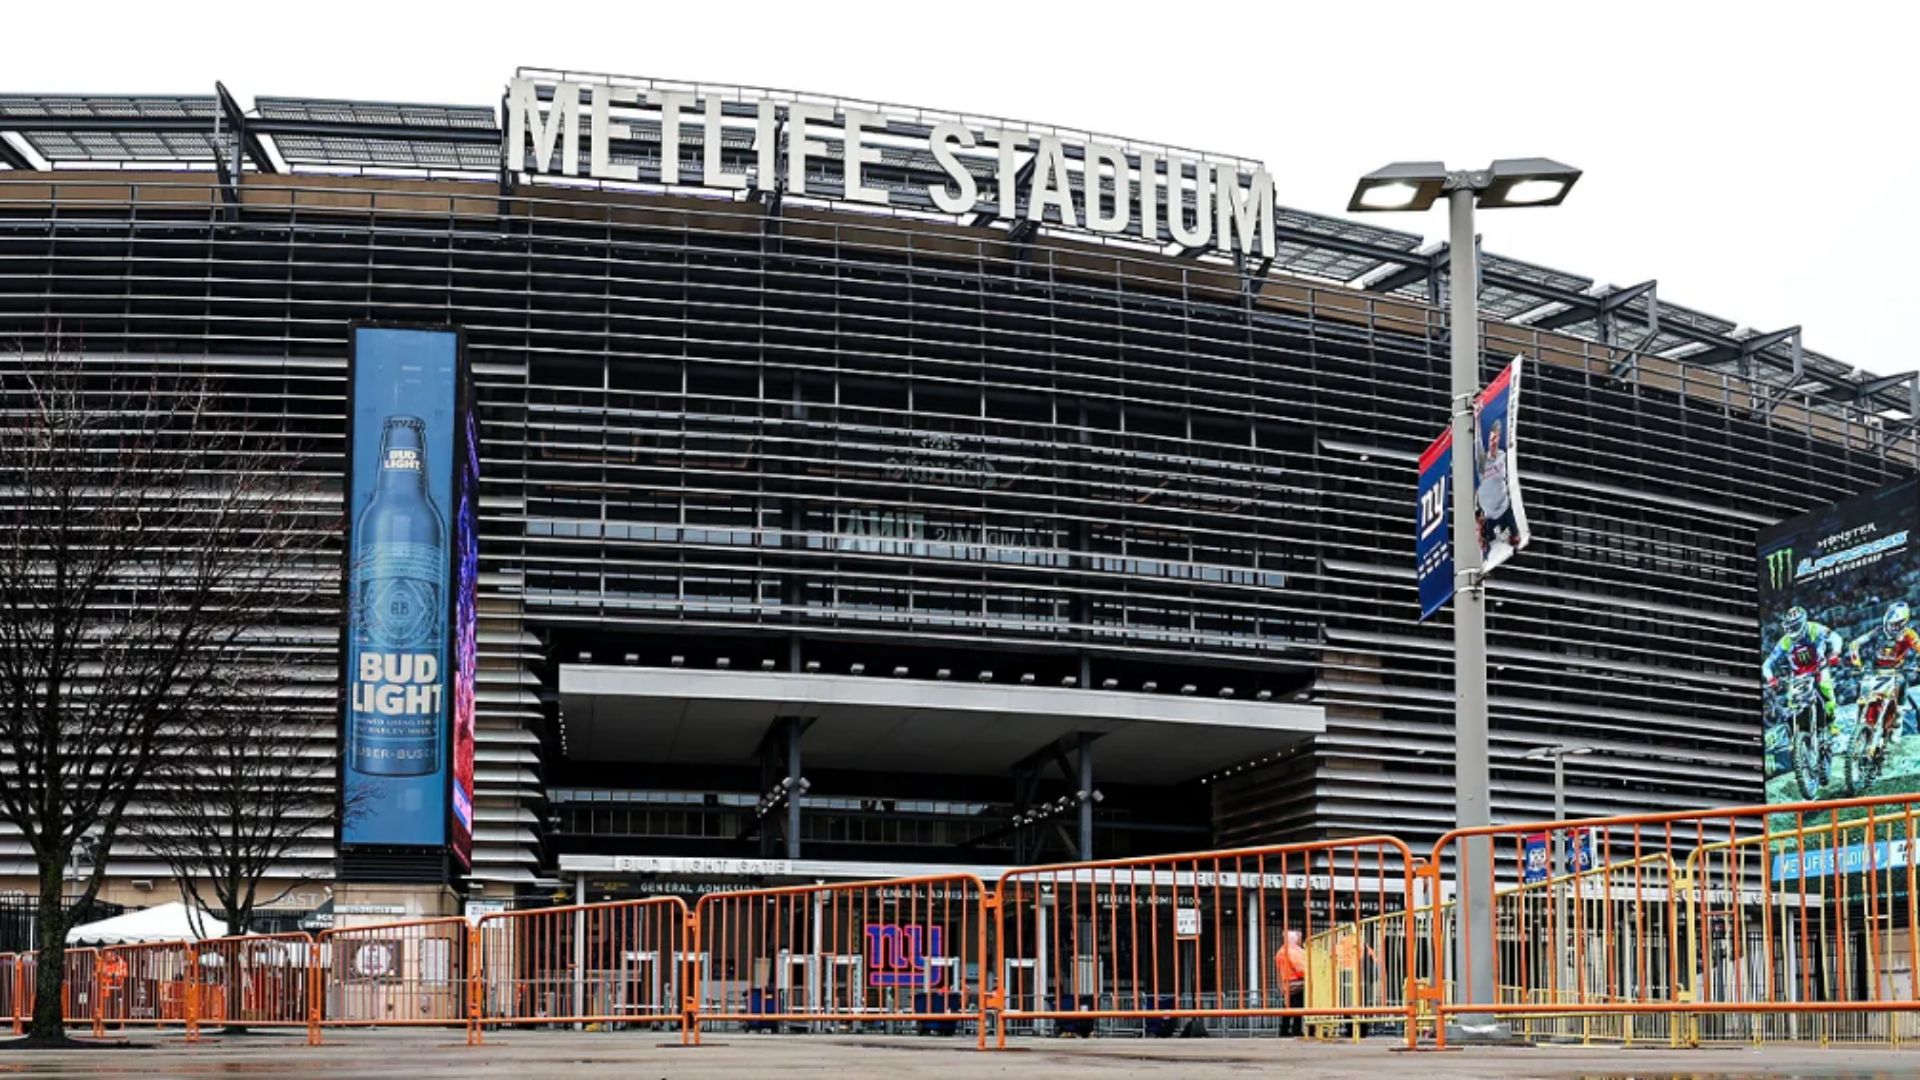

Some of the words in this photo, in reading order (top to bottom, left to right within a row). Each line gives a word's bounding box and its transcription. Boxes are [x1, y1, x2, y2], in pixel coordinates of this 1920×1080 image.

[508, 76, 889, 204] METLIFE
[927, 121, 1277, 260] STADIUM
[384, 459, 421, 470] LIGHT
[389, 450, 417, 460] BUD
[1817, 522, 1877, 548] MONSTER
[359, 651, 438, 683] BUD
[352, 682, 443, 715] LIGHT
[621, 858, 657, 870] BUD
[671, 859, 728, 872] LIGHT
[737, 860, 786, 874] GATE
[640, 881, 694, 894] GENERAL
